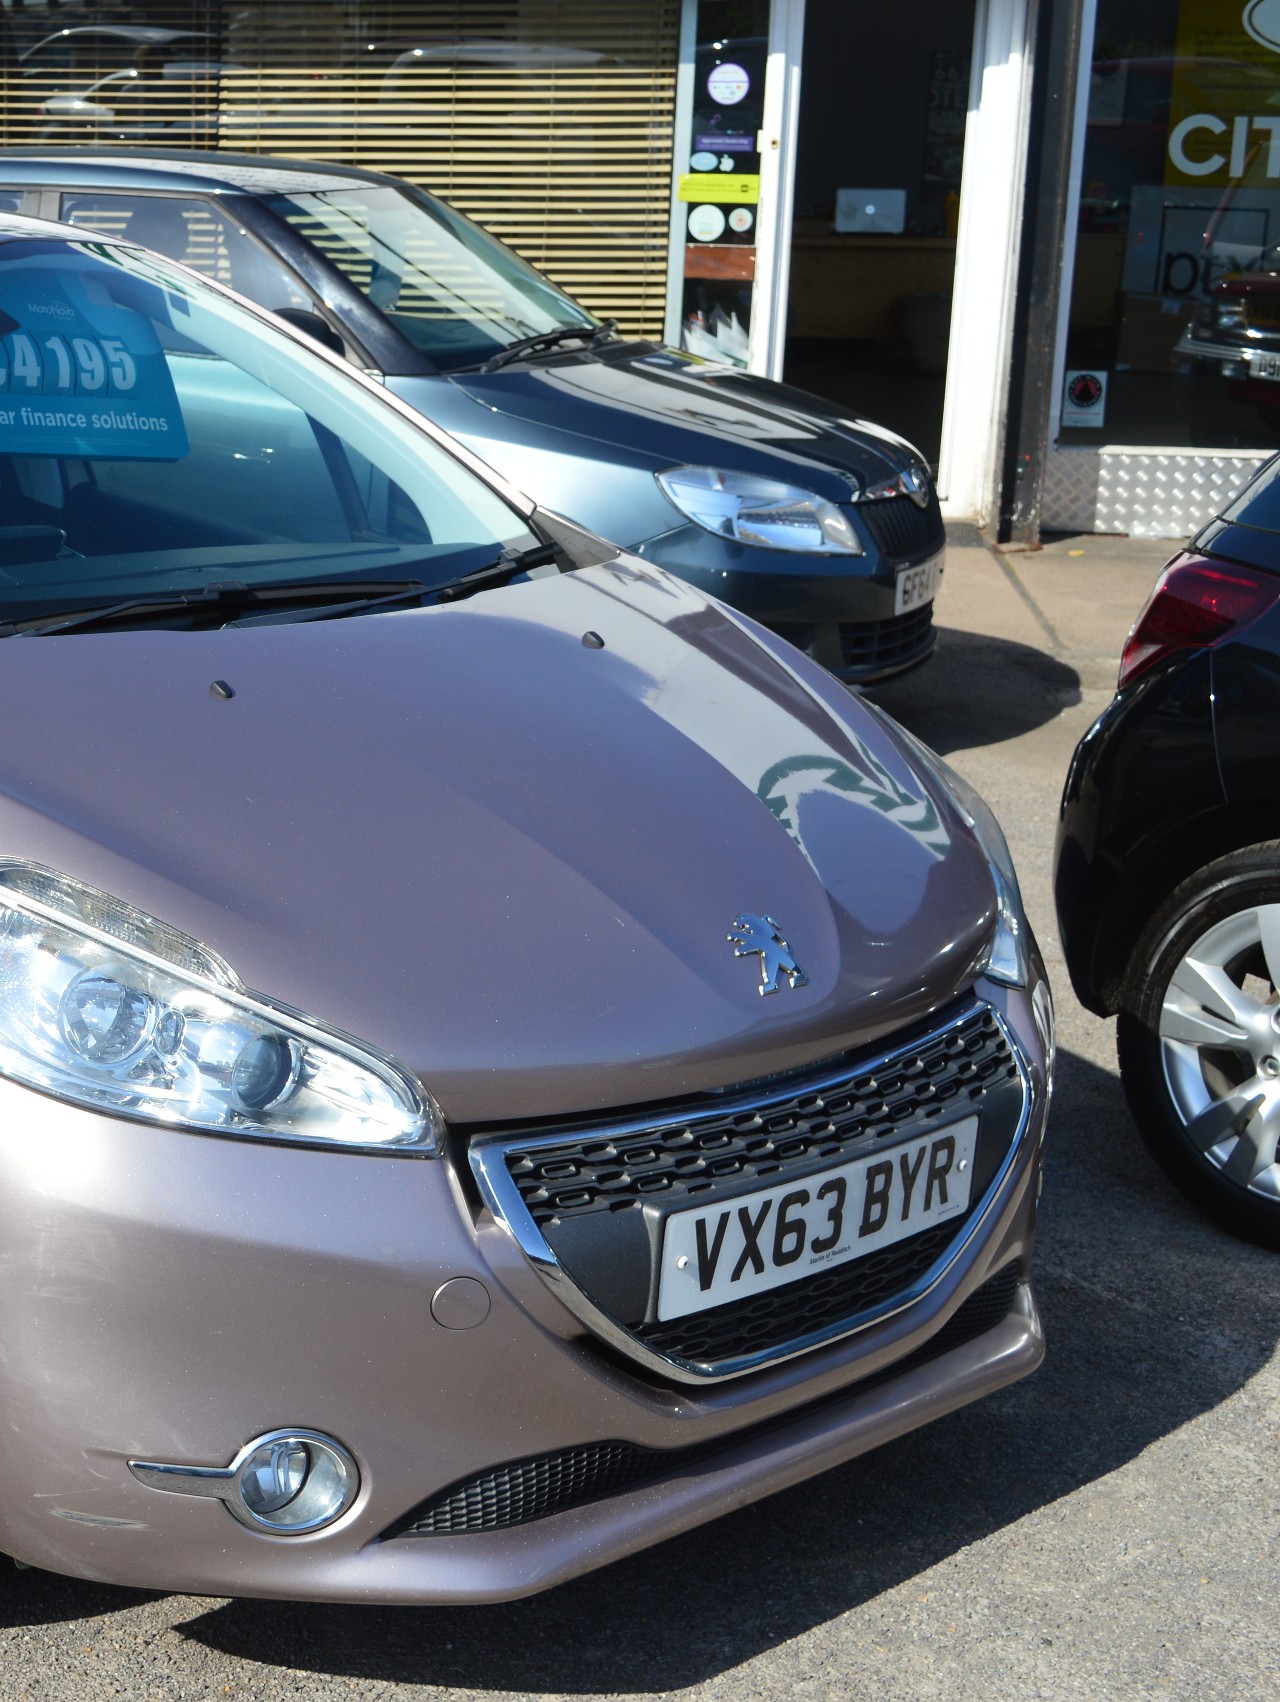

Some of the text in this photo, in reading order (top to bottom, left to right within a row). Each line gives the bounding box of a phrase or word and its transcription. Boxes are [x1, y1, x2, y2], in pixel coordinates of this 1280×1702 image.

[20, 408, 87, 428] finance
[92, 411, 168, 432] solutions
[695, 1135, 956, 1292] VX63 BYR
